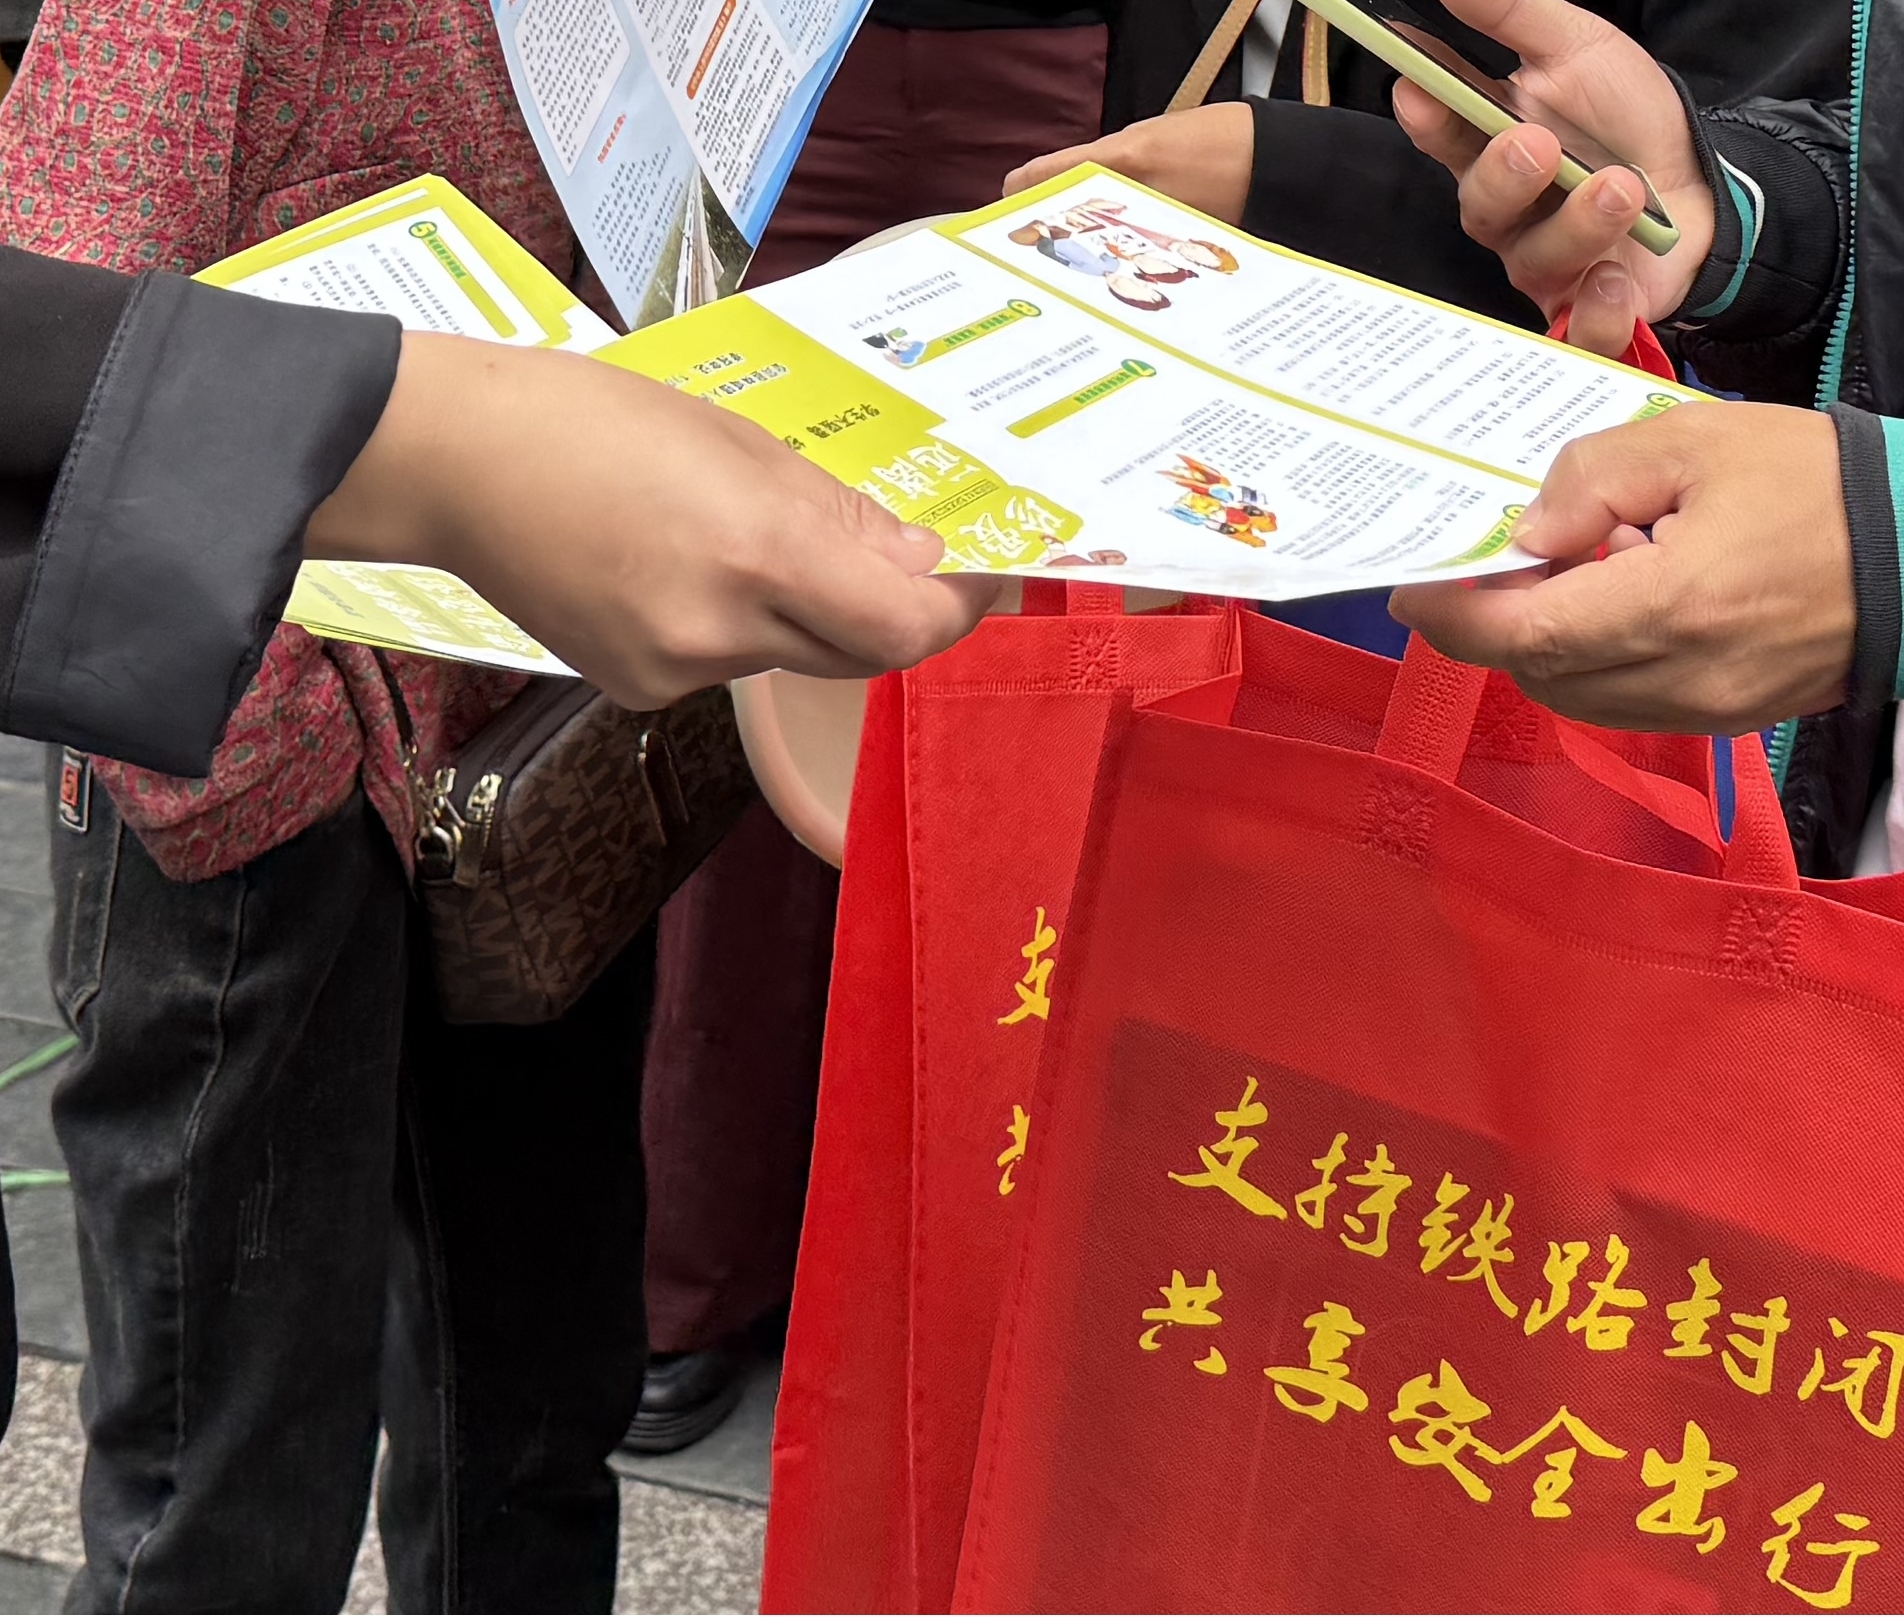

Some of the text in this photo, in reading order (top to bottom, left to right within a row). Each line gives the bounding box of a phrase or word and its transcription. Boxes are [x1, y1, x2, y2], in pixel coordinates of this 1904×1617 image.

[1139, 1269, 1881, 1609] 共享安全出行
